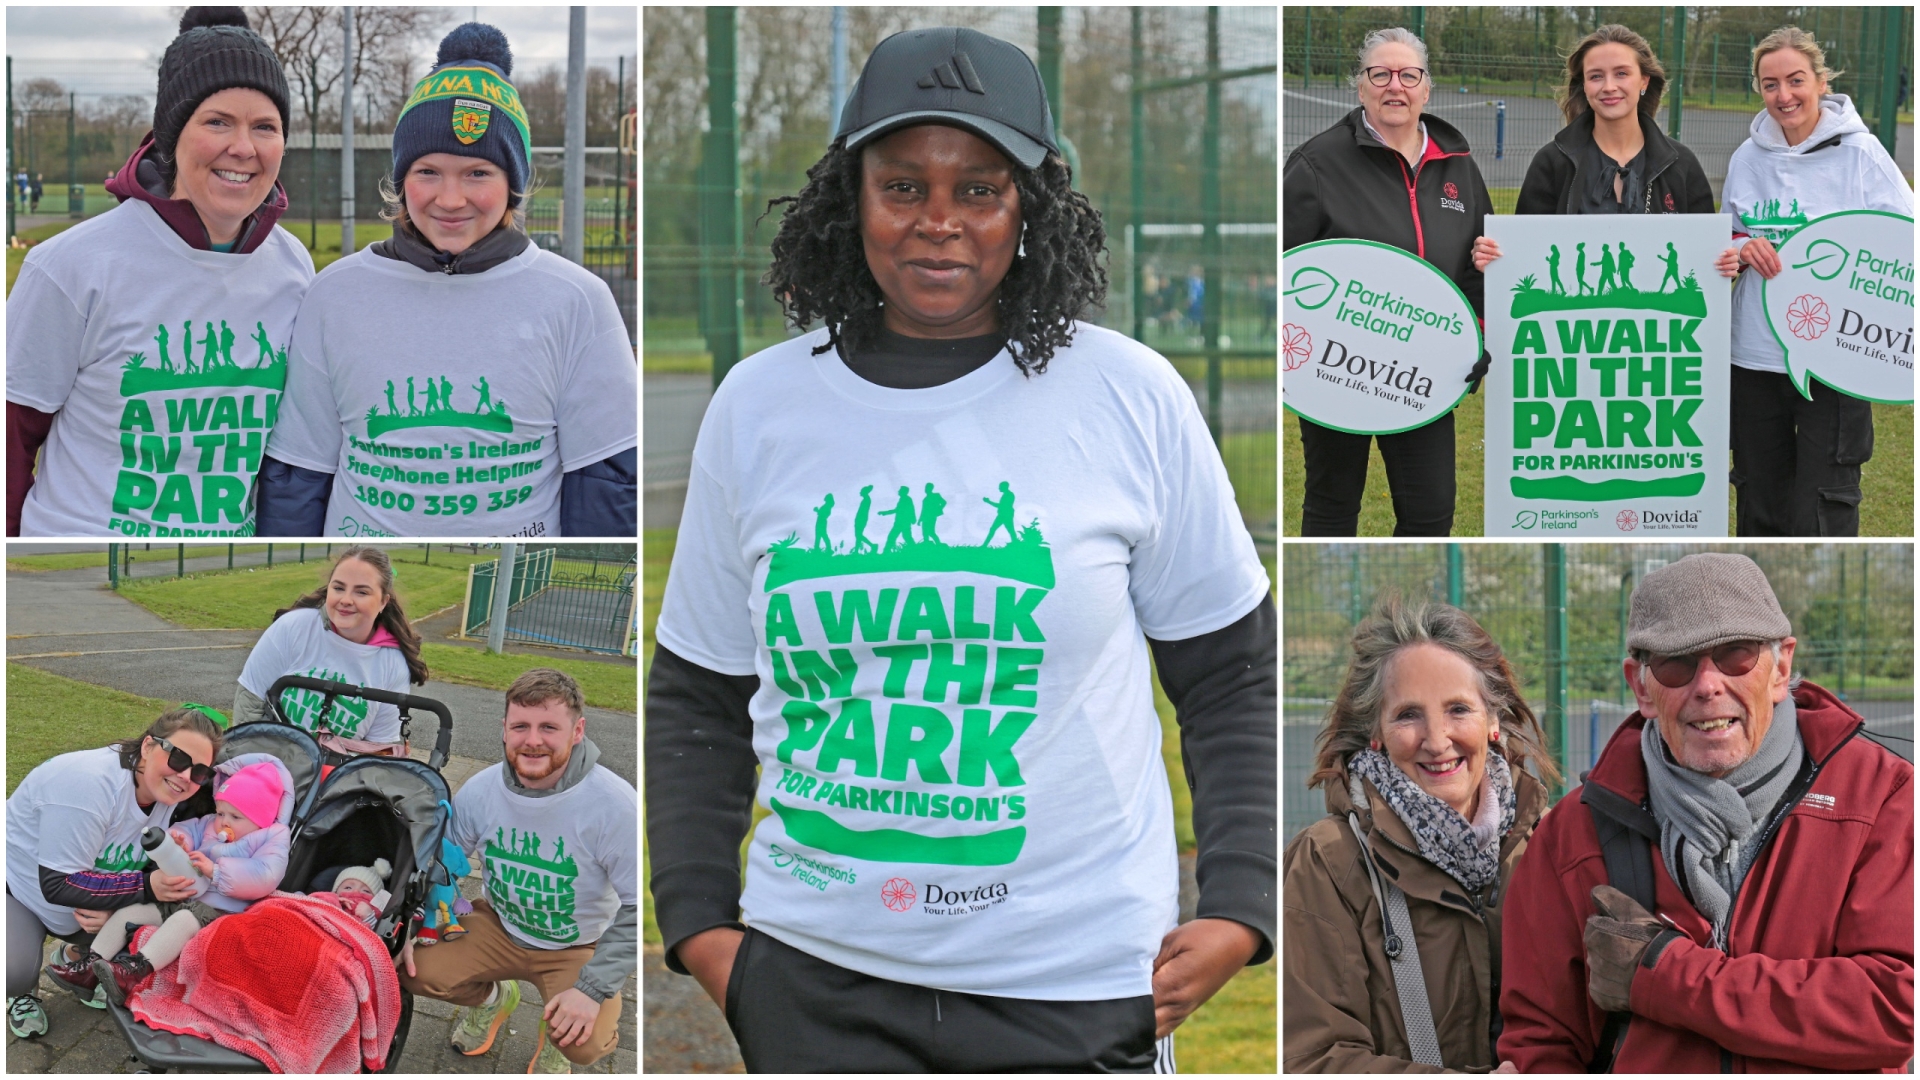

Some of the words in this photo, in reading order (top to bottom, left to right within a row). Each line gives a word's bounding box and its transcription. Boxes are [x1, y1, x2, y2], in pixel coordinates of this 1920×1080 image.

[436, 75, 473, 92] NA
[1335, 301, 1414, 342] Ireland
[1344, 279, 1464, 335] Parkinson's
[1511, 319, 1547, 354] A
[1555, 318, 1703, 354] WALK
[1837, 308, 1914, 354] Dovi
[1317, 338, 1434, 398] Dovida
[1836, 337, 1862, 353] Your
[1864, 346, 1888, 363] Life,
[1892, 354, 1914, 371] You
[1316, 368, 1343, 385] Your
[1345, 377, 1370, 395] Life,
[1374, 386, 1400, 404] Your
[1403, 395, 1426, 411] Way
[1513, 357, 1577, 398] IN
[1590, 356, 1702, 397] THE
[119, 398, 155, 433] A
[1513, 399, 1704, 449] PARK
[120, 432, 181, 474] IN
[193, 431, 271, 474] TH
[349, 435, 463, 460] Parkinson's
[469, 435, 545, 459] Ireland
[1513, 455, 1555, 471] FOR
[1560, 452, 1703, 470] PARKINSON'S
[347, 455, 449, 484] Freephone
[456, 459, 543, 484] Helpline
[112, 469, 257, 525] PAR
[354, 485, 415, 512] 1800
[423, 494, 478, 515] 359
[487, 485, 532, 512] 359
[1541, 509, 1599, 519] Parkinson's
[108, 517, 151, 537] FOR
[1541, 520, 1577, 529] Ireland
[1642, 510, 1698, 523] Dovida
[765, 593, 803, 647] A
[813, 585, 1050, 644] WALK
[768, 648, 858, 702] IN
[872, 643, 1044, 708] THE
[284, 686, 299, 700] A
[281, 697, 306, 724] IN
[776, 698, 1038, 787] PARK
[775, 768, 817, 799] FOR
[813, 780, 1027, 821] PARKINSON'S
[501, 863, 576, 894] WALK
[791, 863, 830, 892] Ireland
[794, 853, 857, 885] Parkinson's
[489, 876, 508, 902] IN
[515, 887, 575, 911] THE
[923, 906, 945, 915] Your
[948, 907, 967, 915] Life,
[969, 903, 989, 912] Your
[924, 882, 1008, 905] Dovida
